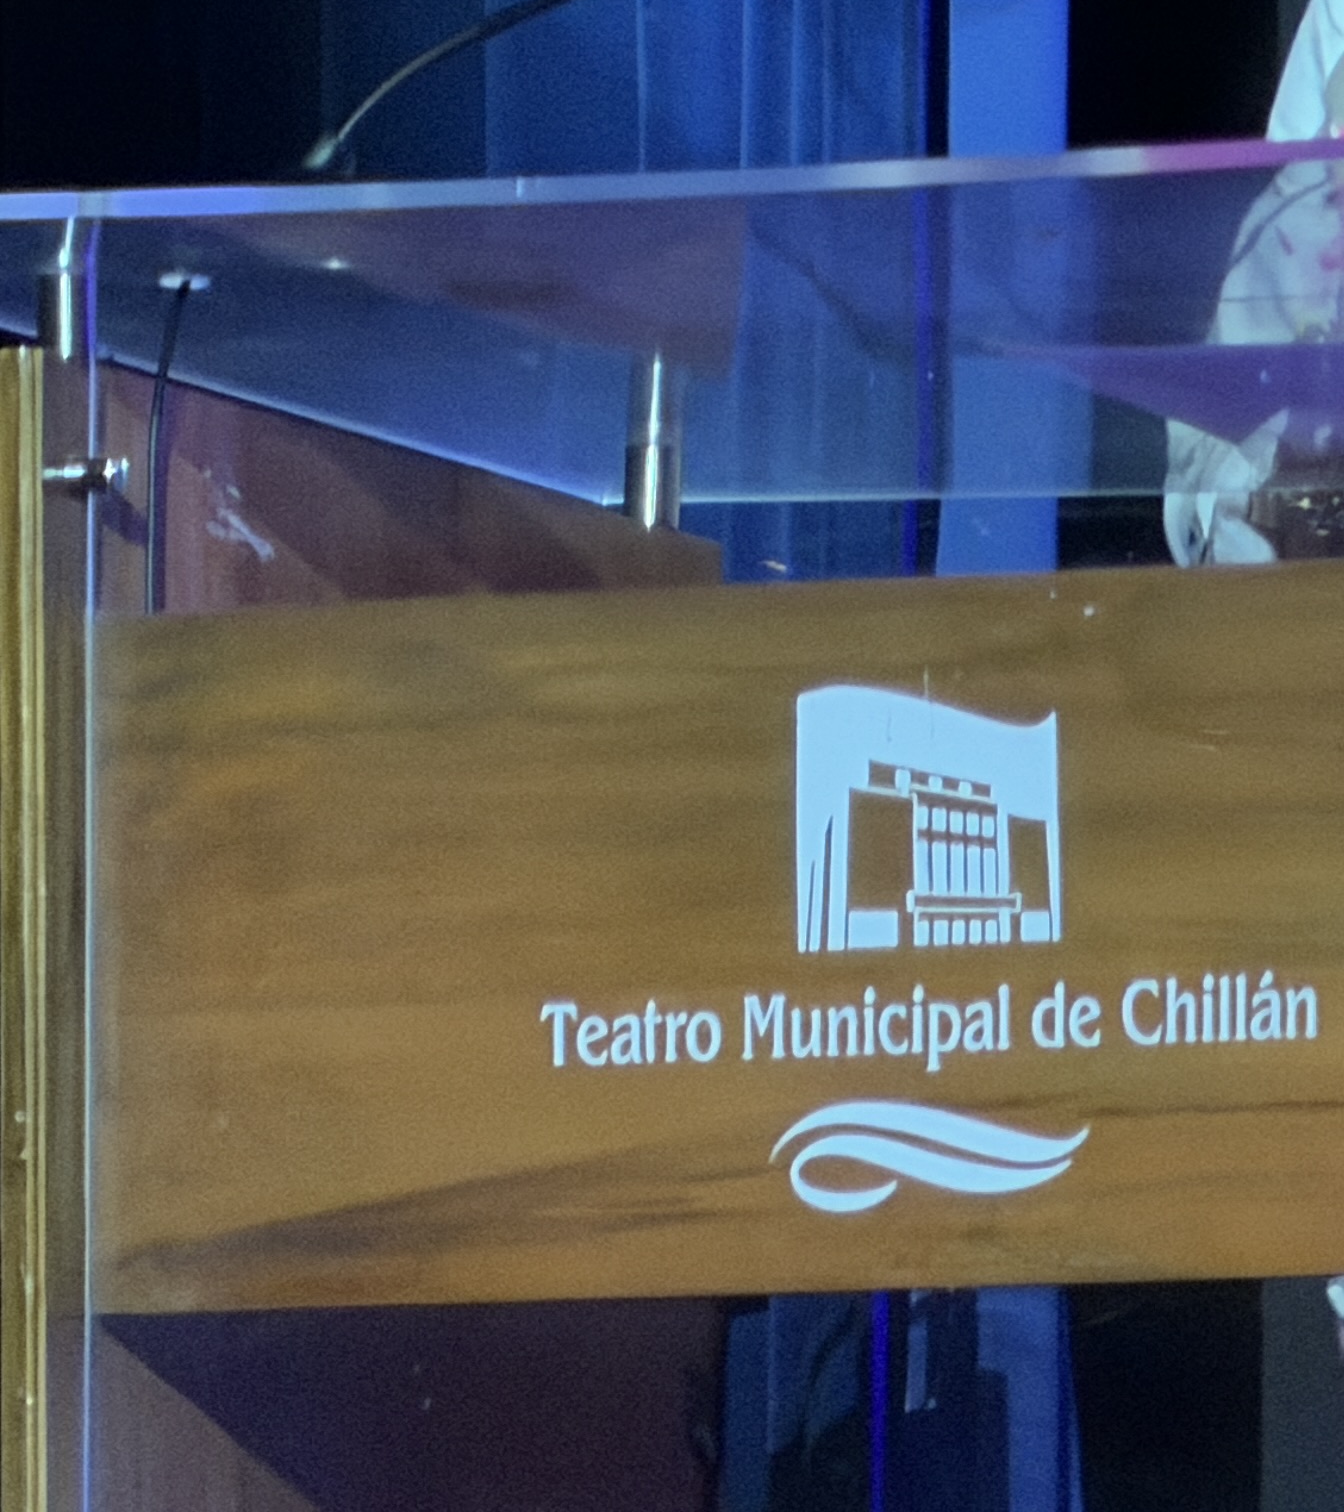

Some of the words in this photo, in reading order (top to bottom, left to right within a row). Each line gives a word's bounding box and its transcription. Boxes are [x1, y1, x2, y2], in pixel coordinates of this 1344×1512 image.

[540, 998, 722, 1068] Teatro
[741, 983, 1011, 1072] Municipal
[1030, 980, 1102, 1049] de
[1120, 969, 1319, 1046] Chillán
